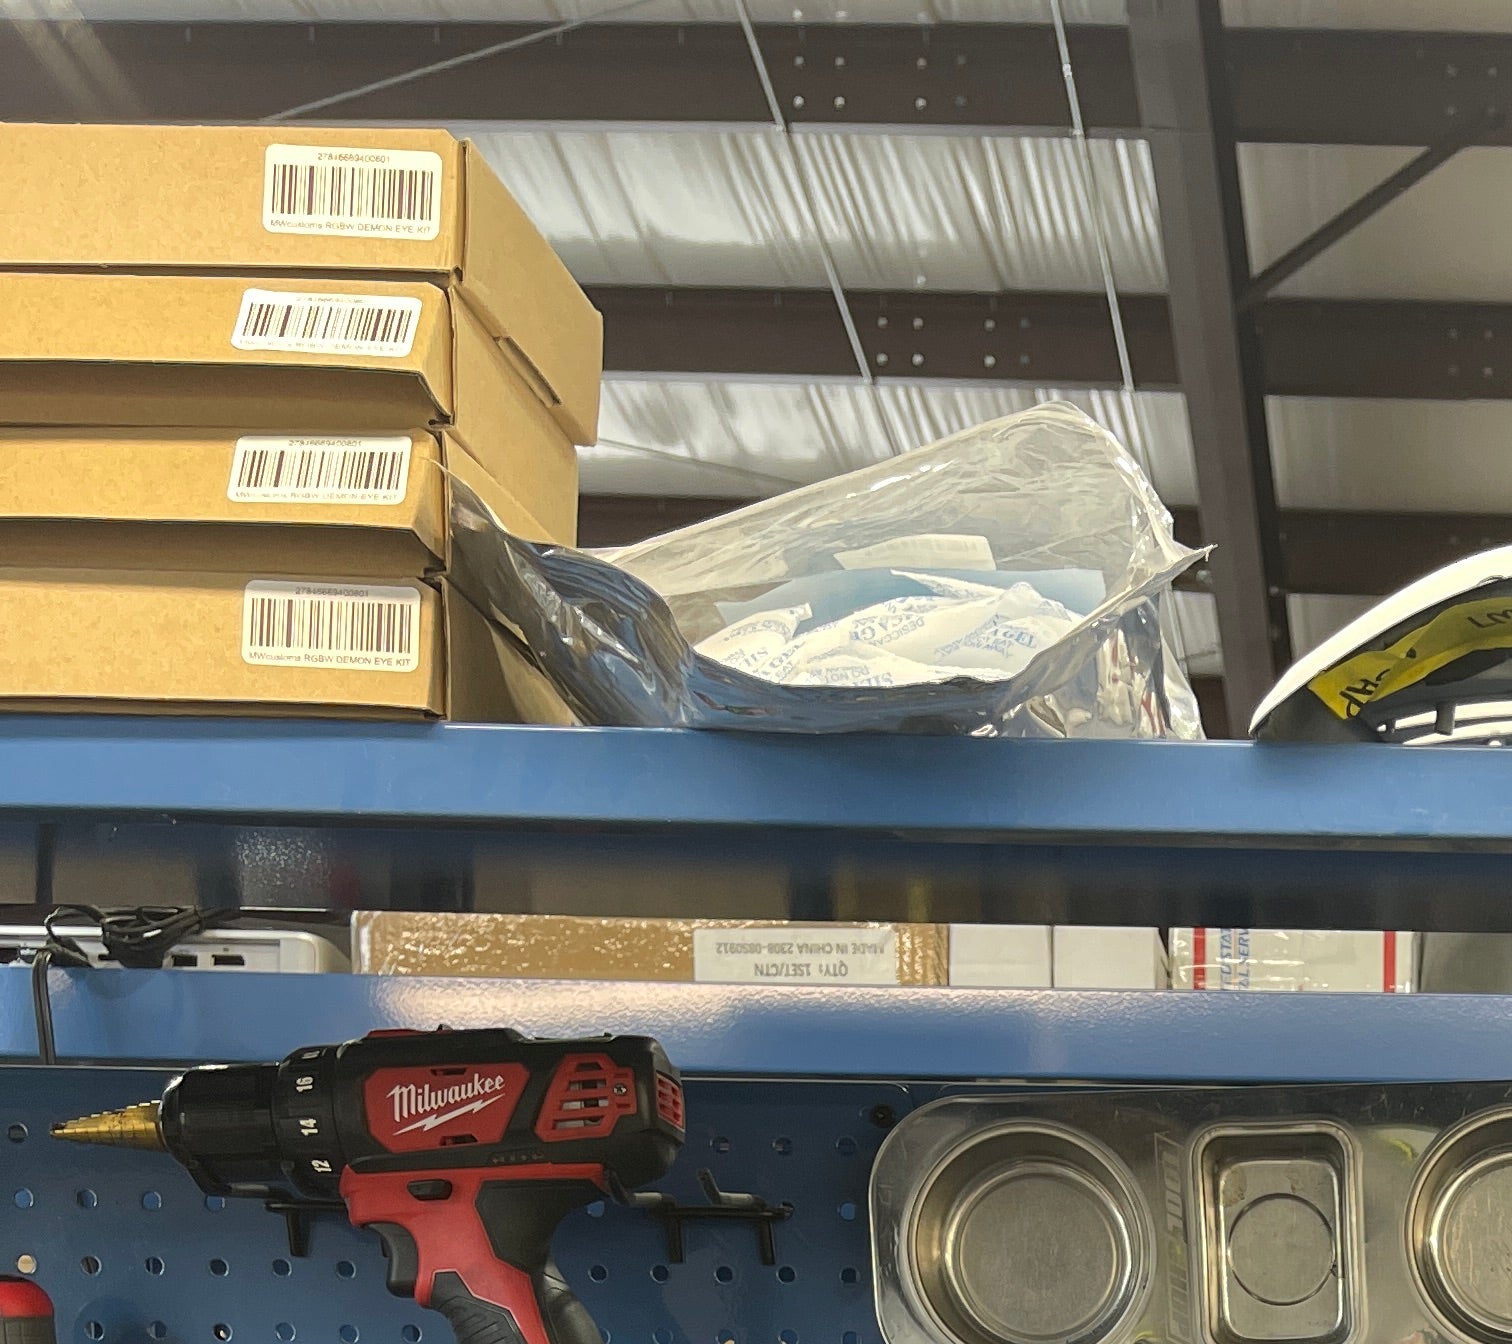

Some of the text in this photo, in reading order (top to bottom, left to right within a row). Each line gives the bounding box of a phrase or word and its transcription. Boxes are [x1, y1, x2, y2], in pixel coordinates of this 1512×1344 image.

[325, 222, 355, 231] RGBW
[357, 223, 393, 233] DEMON
[395, 225, 413, 234] EYE
[417, 226, 431, 234] KIT
[304, 654, 333, 663] RGBW
[336, 655, 372, 665] DEMON
[374, 658, 393, 666] EYE
[395, 658, 411, 667] KIT
[798, 942, 833, 954] CHINA
[834, 942, 848, 954] IN
[754, 961, 811, 977] 1SET/CTN
[296, 1076, 313, 1092] 16
[385, 1072, 505, 1123] Milwaukee
[300, 1118, 318, 1136] 14
[311, 1160, 333, 1172] 12
